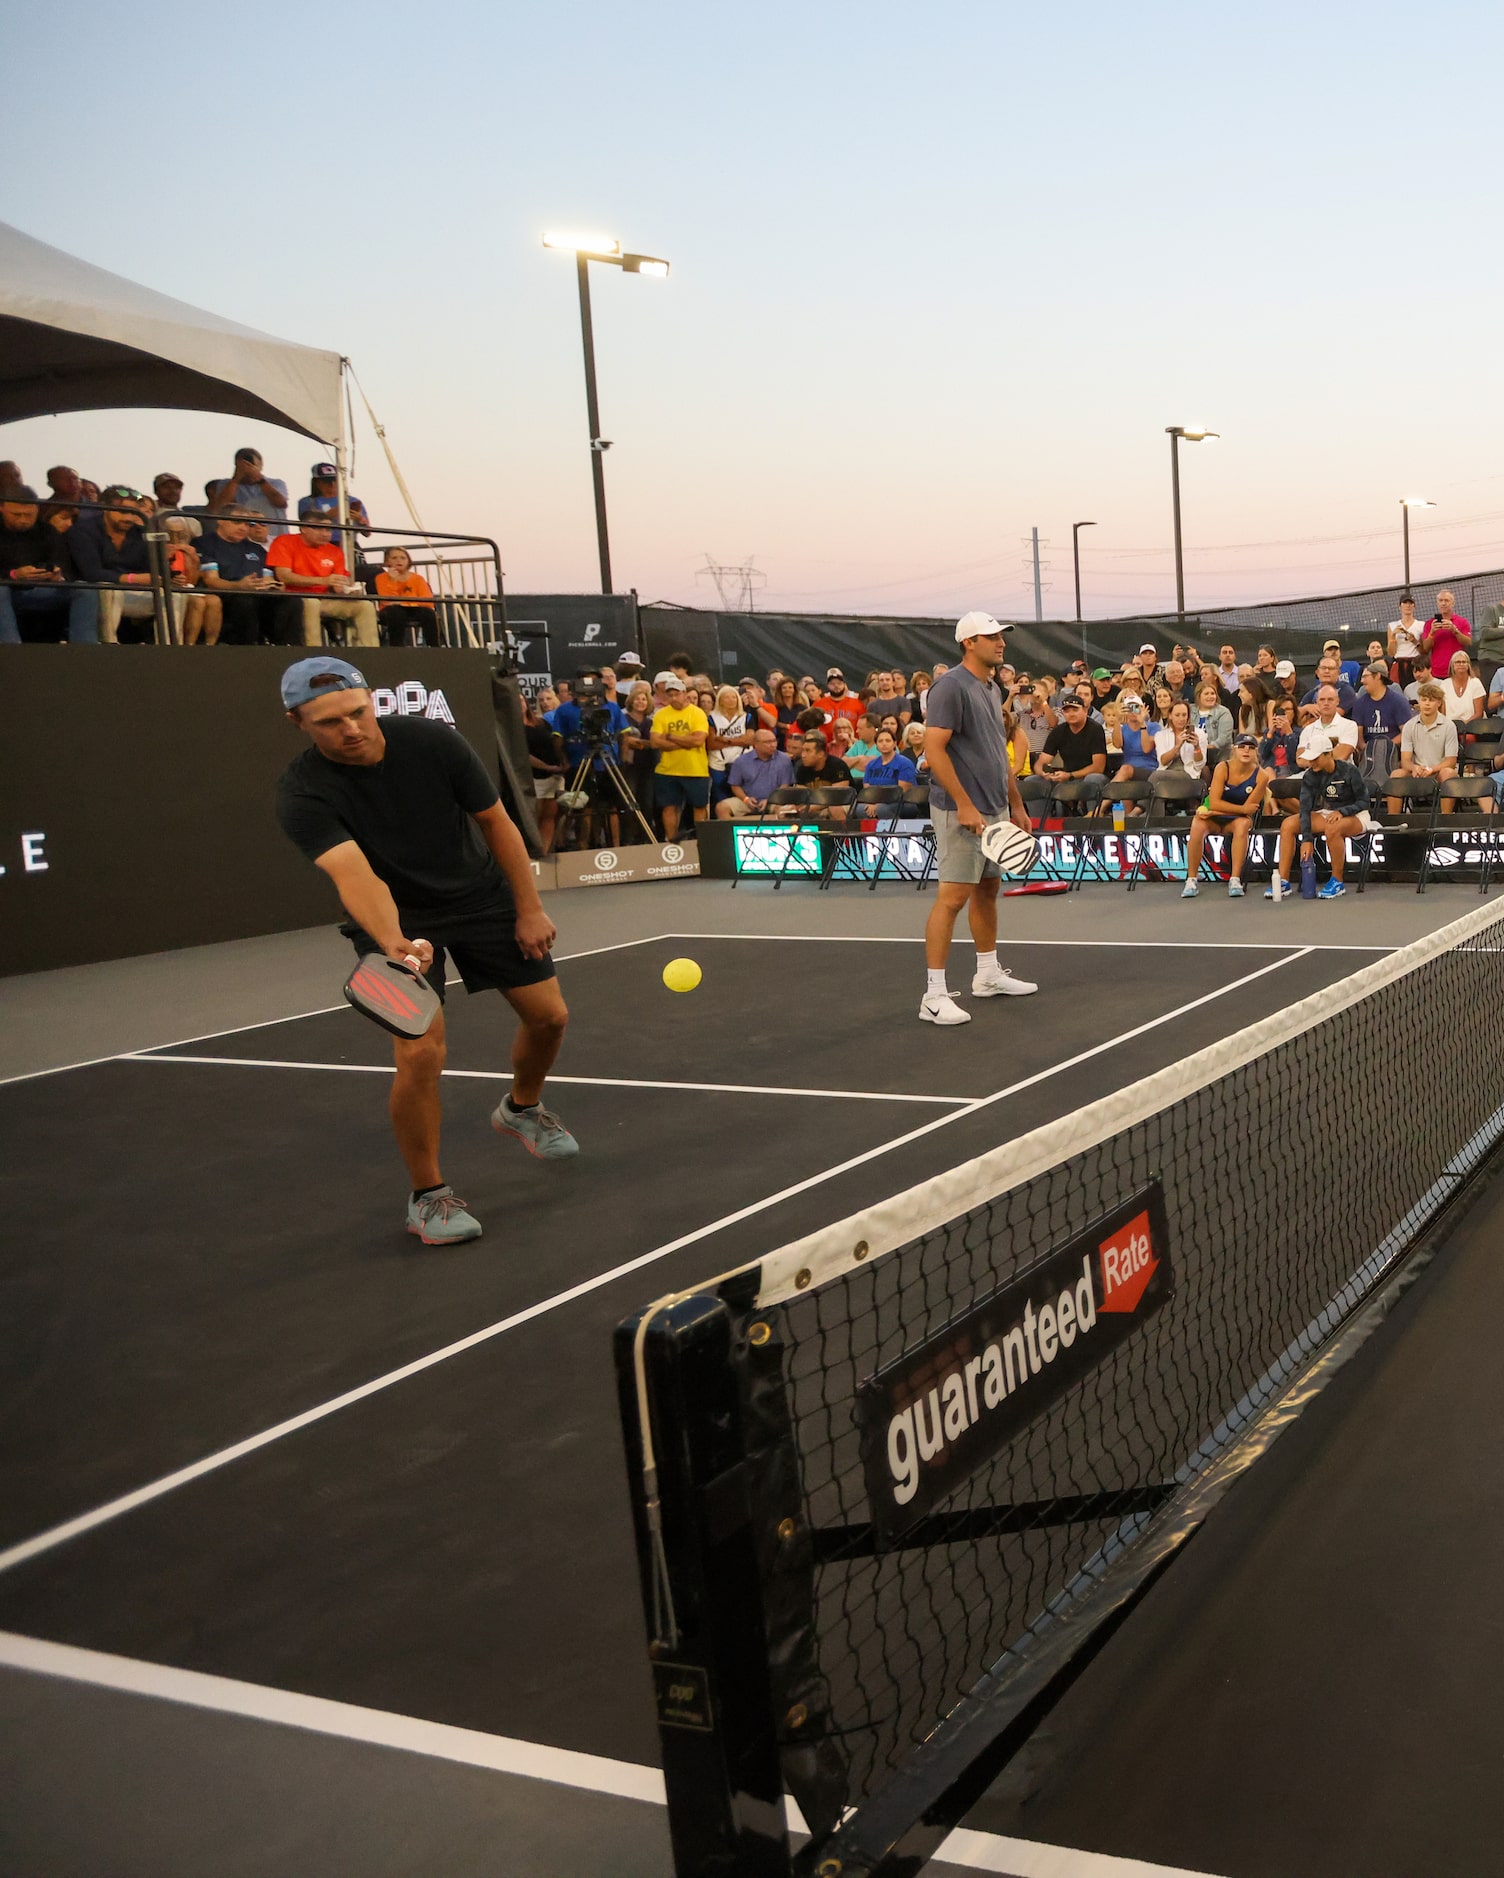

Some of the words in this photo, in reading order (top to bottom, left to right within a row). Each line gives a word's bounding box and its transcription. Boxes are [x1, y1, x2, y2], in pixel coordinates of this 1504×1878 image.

[371, 681, 456, 723] PPA
[668, 720, 691, 733] PPA
[865, 836, 923, 863] PPA
[1040, 834, 1225, 864] CELEBRIY
[579, 869, 635, 882] ONESHOT
[646, 862, 701, 874] ONESHOT
[887, 1254, 1097, 1505] guaranteed
[1103, 1232, 1150, 1294] Rate
